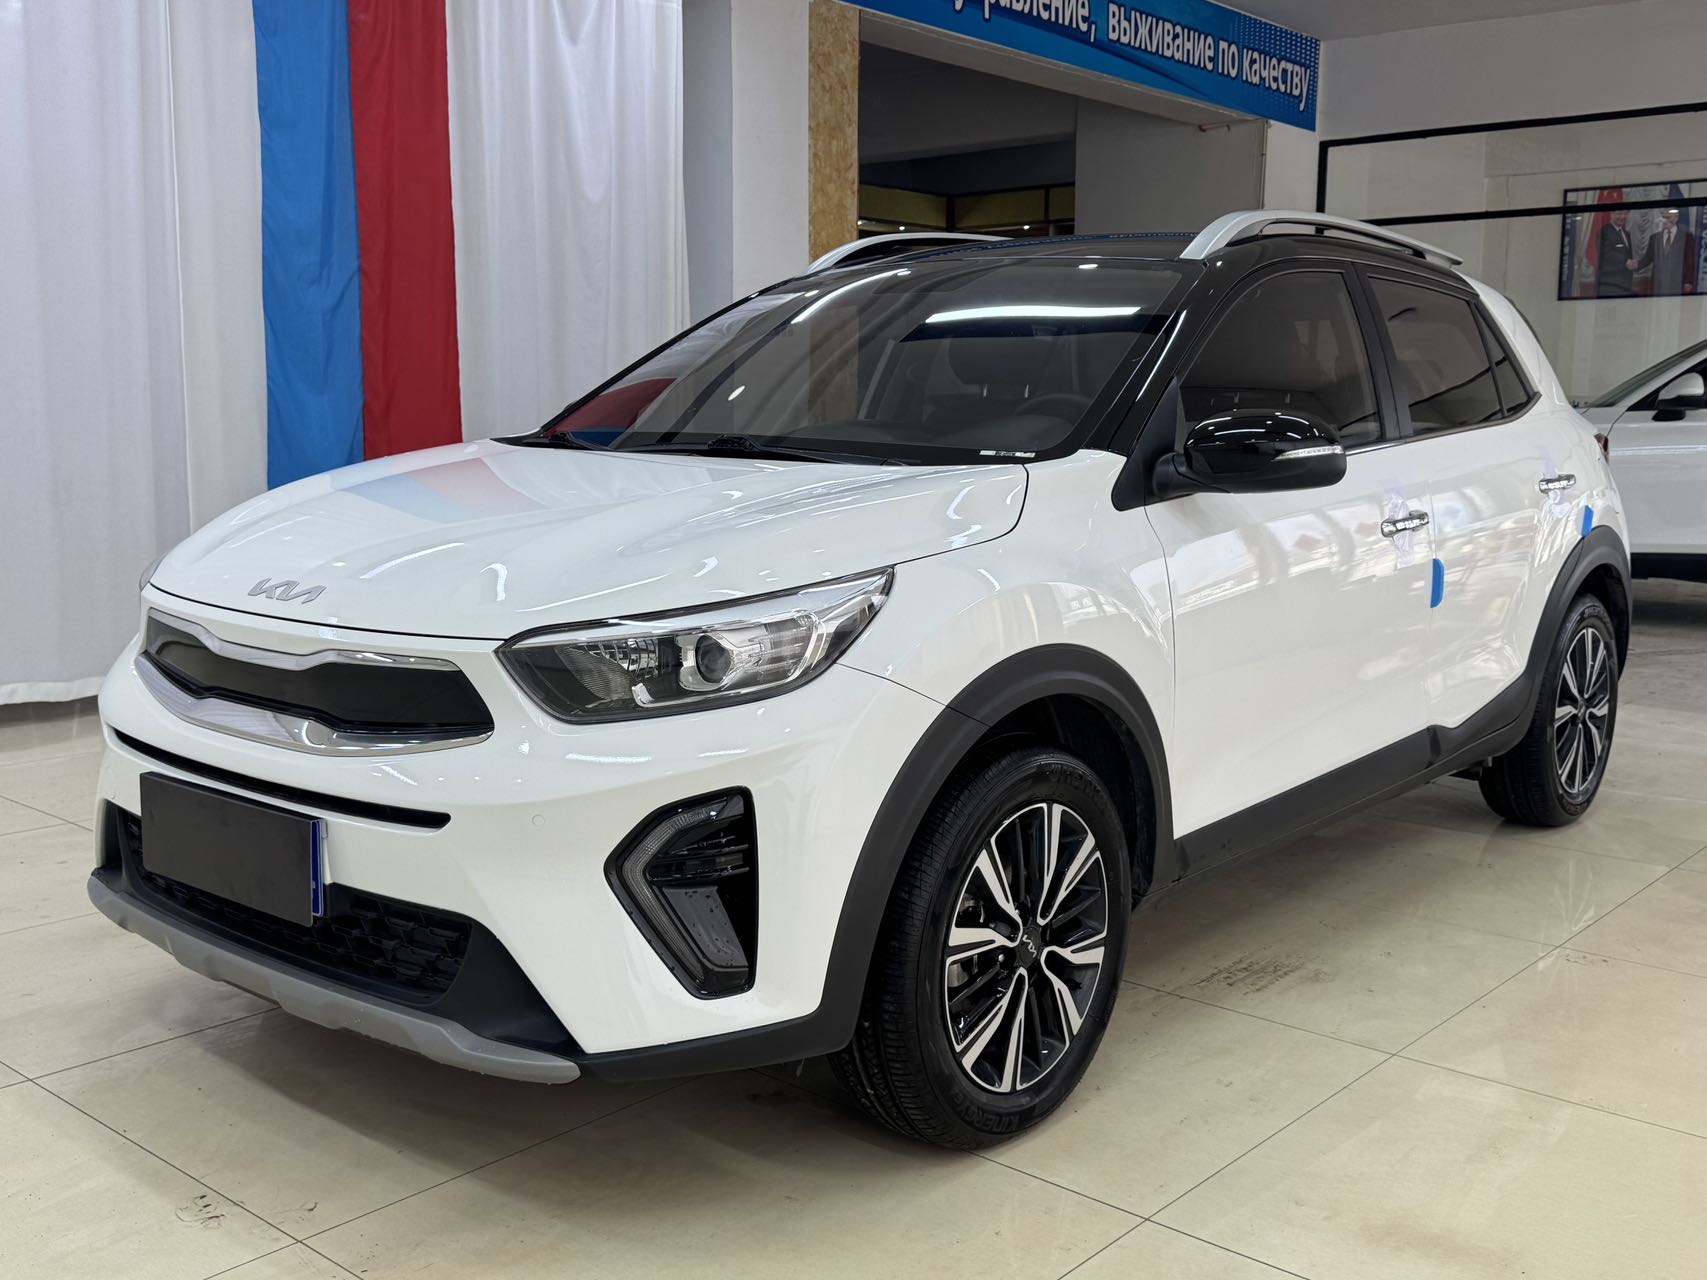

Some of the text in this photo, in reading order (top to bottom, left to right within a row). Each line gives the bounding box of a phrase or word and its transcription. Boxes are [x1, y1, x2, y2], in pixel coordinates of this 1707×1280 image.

[1108, 2, 1214, 71] выживание
[1218, 40, 1239, 78] по
[1242, 48, 1310, 111] качеству
